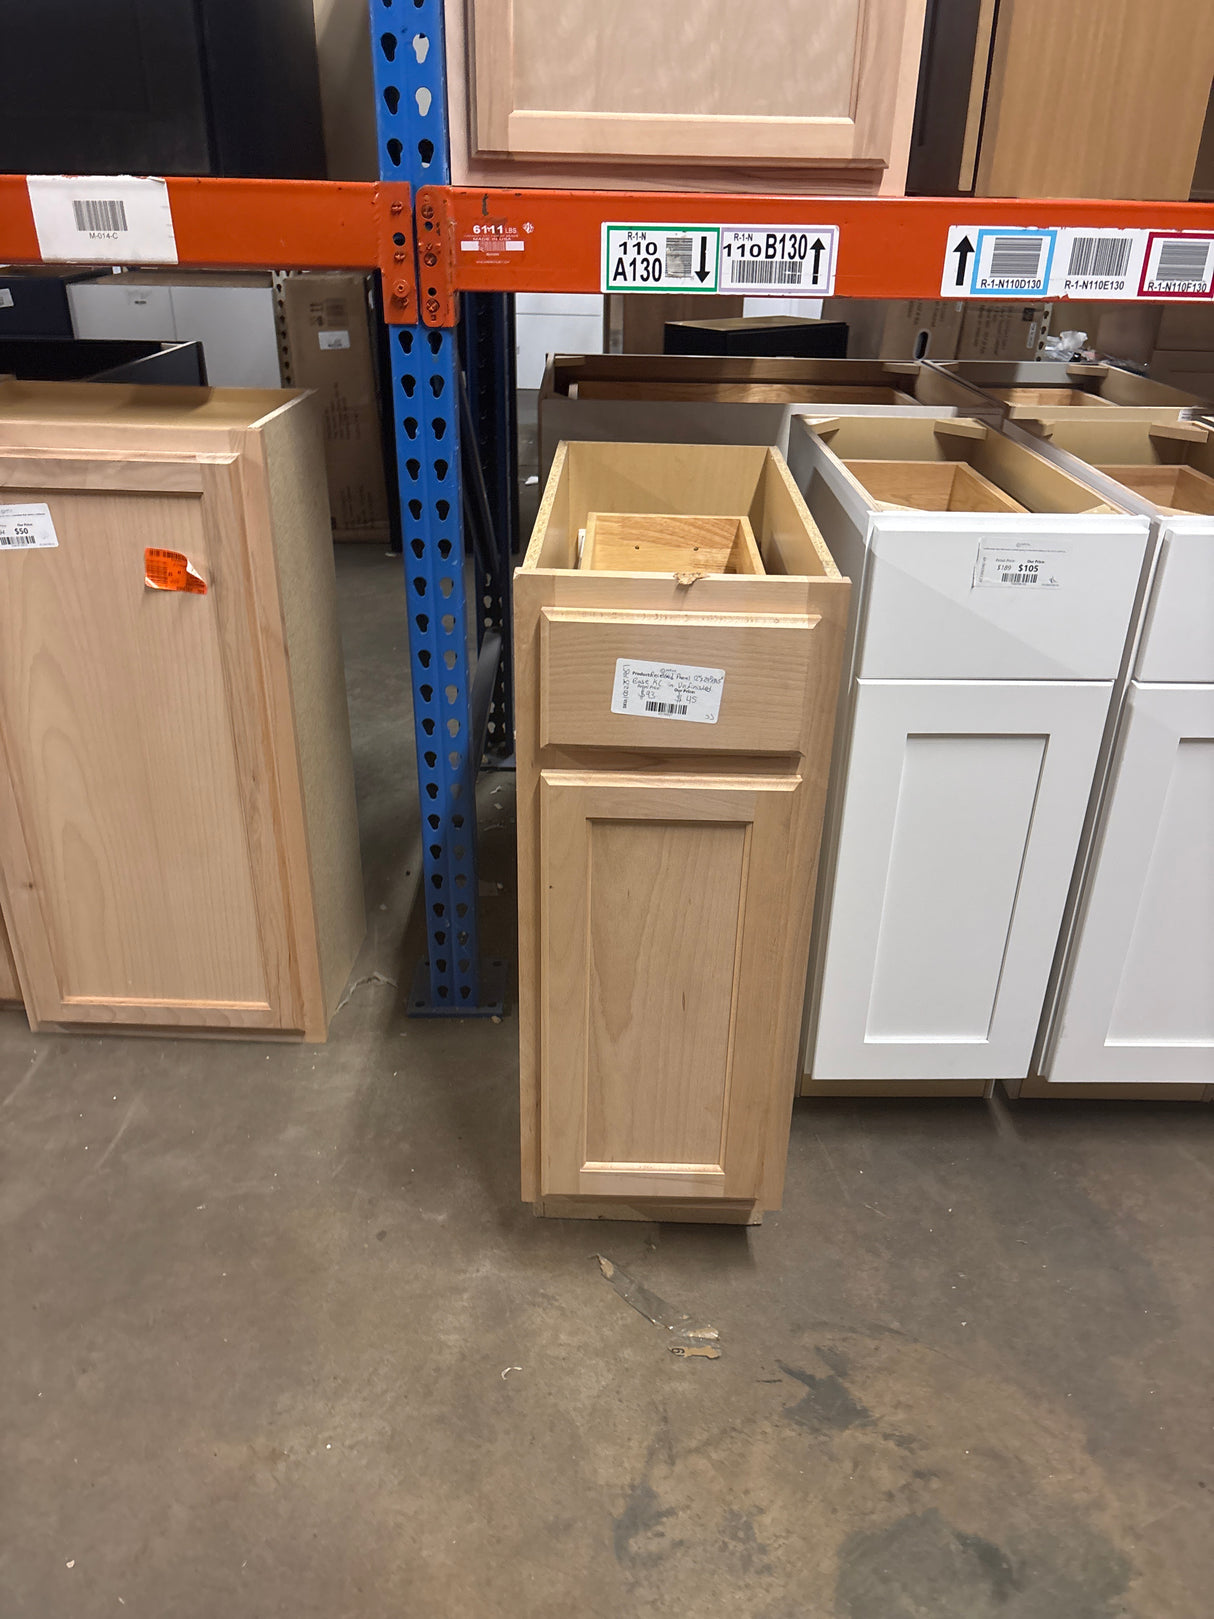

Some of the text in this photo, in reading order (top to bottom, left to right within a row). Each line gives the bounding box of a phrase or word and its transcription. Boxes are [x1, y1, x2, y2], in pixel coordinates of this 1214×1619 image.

[89, 232, 118, 240] M-014-C
[627, 232, 646, 240] R-1-N
[734, 233, 753, 241] R-1-N
[619, 241, 658, 256] 110
[765, 233, 808, 260] B130
[612, 257, 662, 282] A130
[980, 279, 1041, 289] R-1-N110D130
[1064, 280, 1125, 291] R-1-N110E130
[1148, 281, 1207, 292] R-1-N110F130
[14, 527, 29, 535] $50
[1018, 564, 1039, 572] $105
